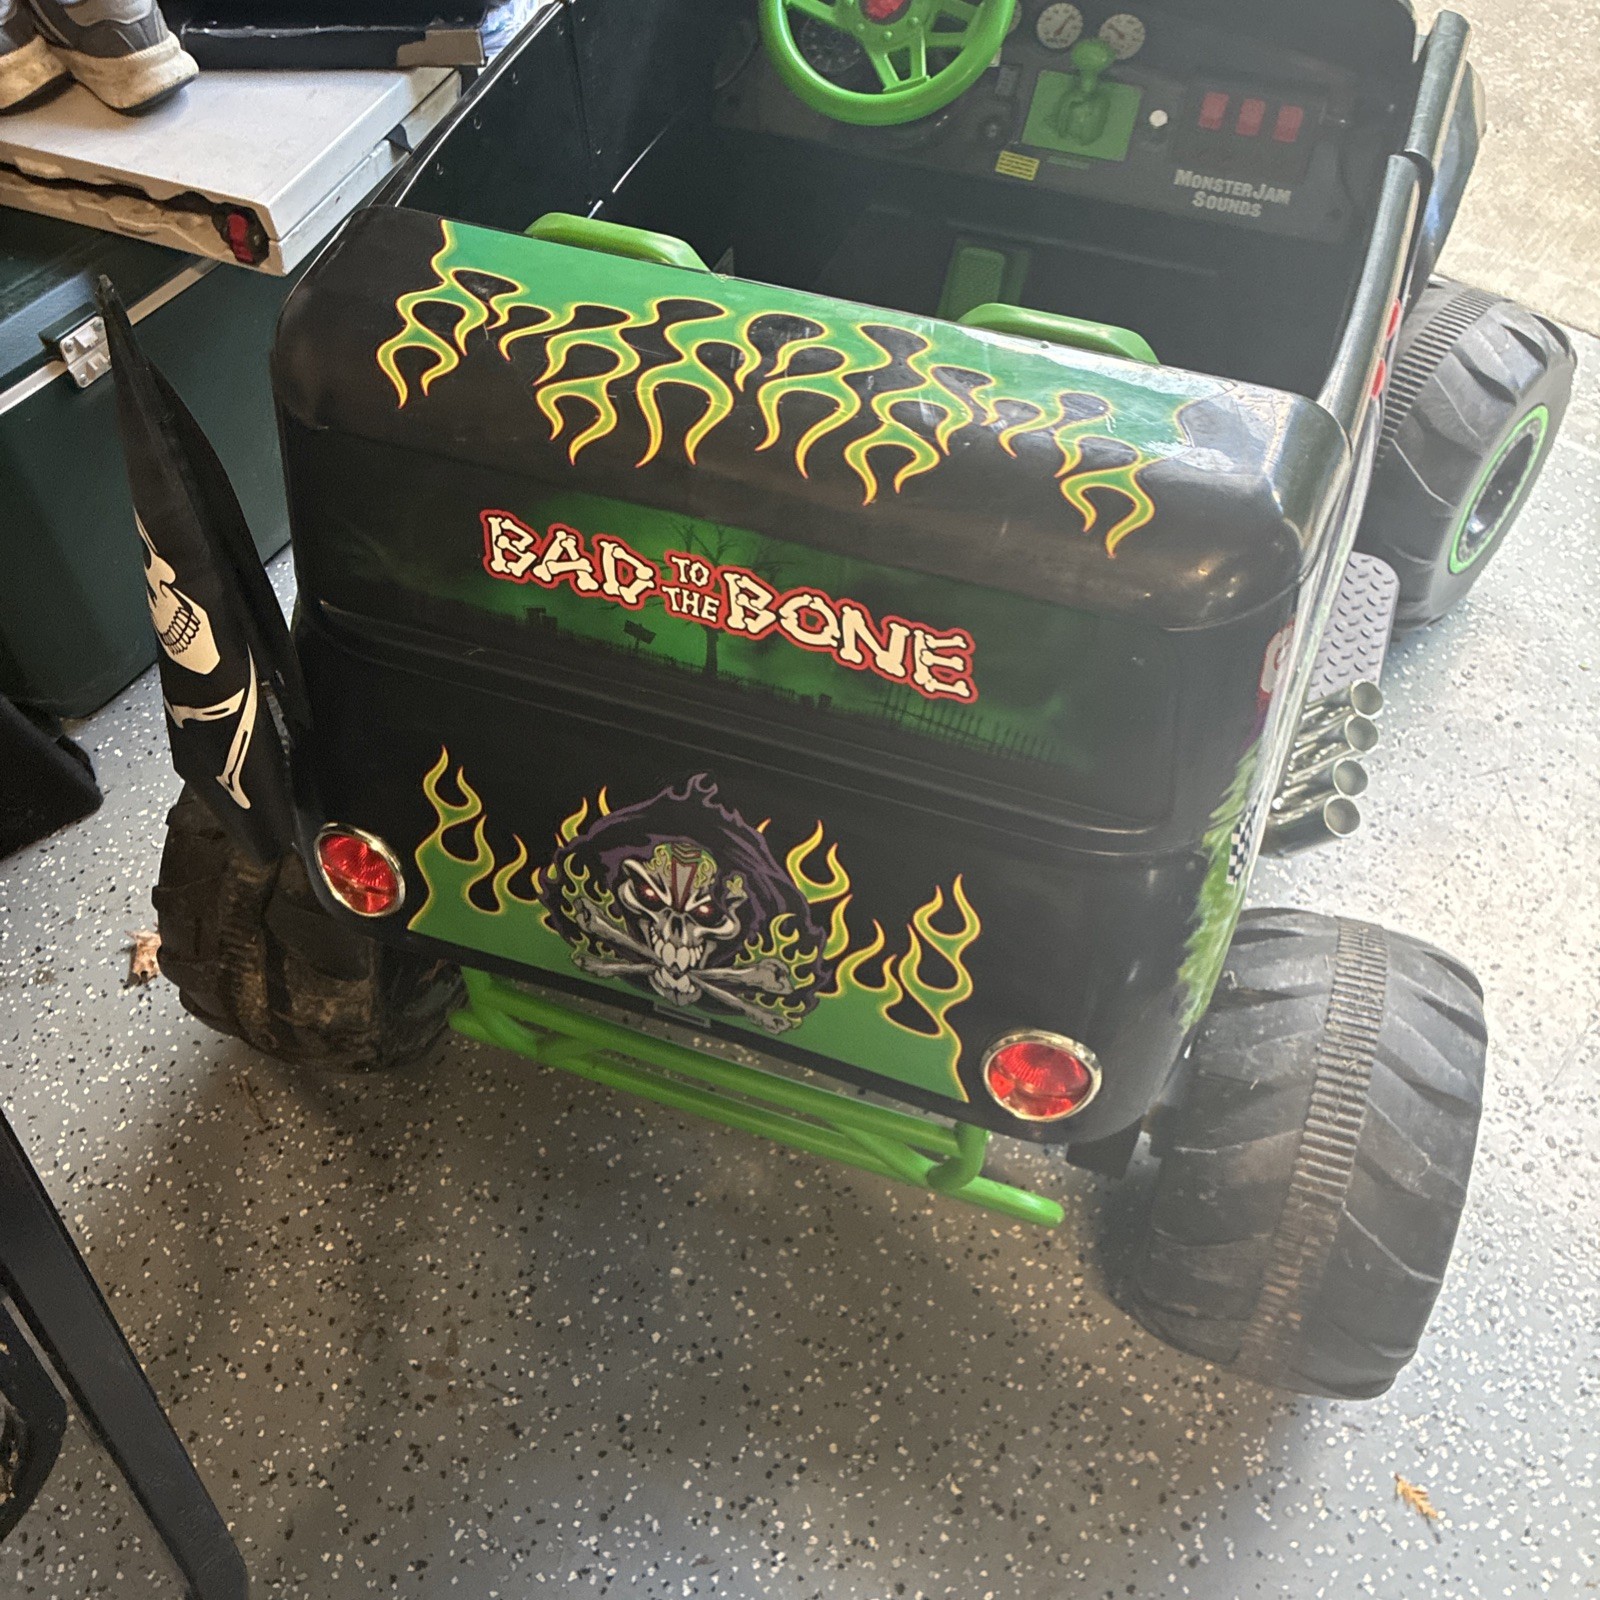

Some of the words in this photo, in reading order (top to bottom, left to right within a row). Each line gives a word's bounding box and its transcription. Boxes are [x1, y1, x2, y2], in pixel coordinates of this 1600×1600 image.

[1192, 190, 1262, 217] SOUNDS
[483, 513, 658, 607] BAD
[669, 555, 712, 588] TO
[660, 584, 721, 624] THE
[721, 569, 974, 700] BONE
